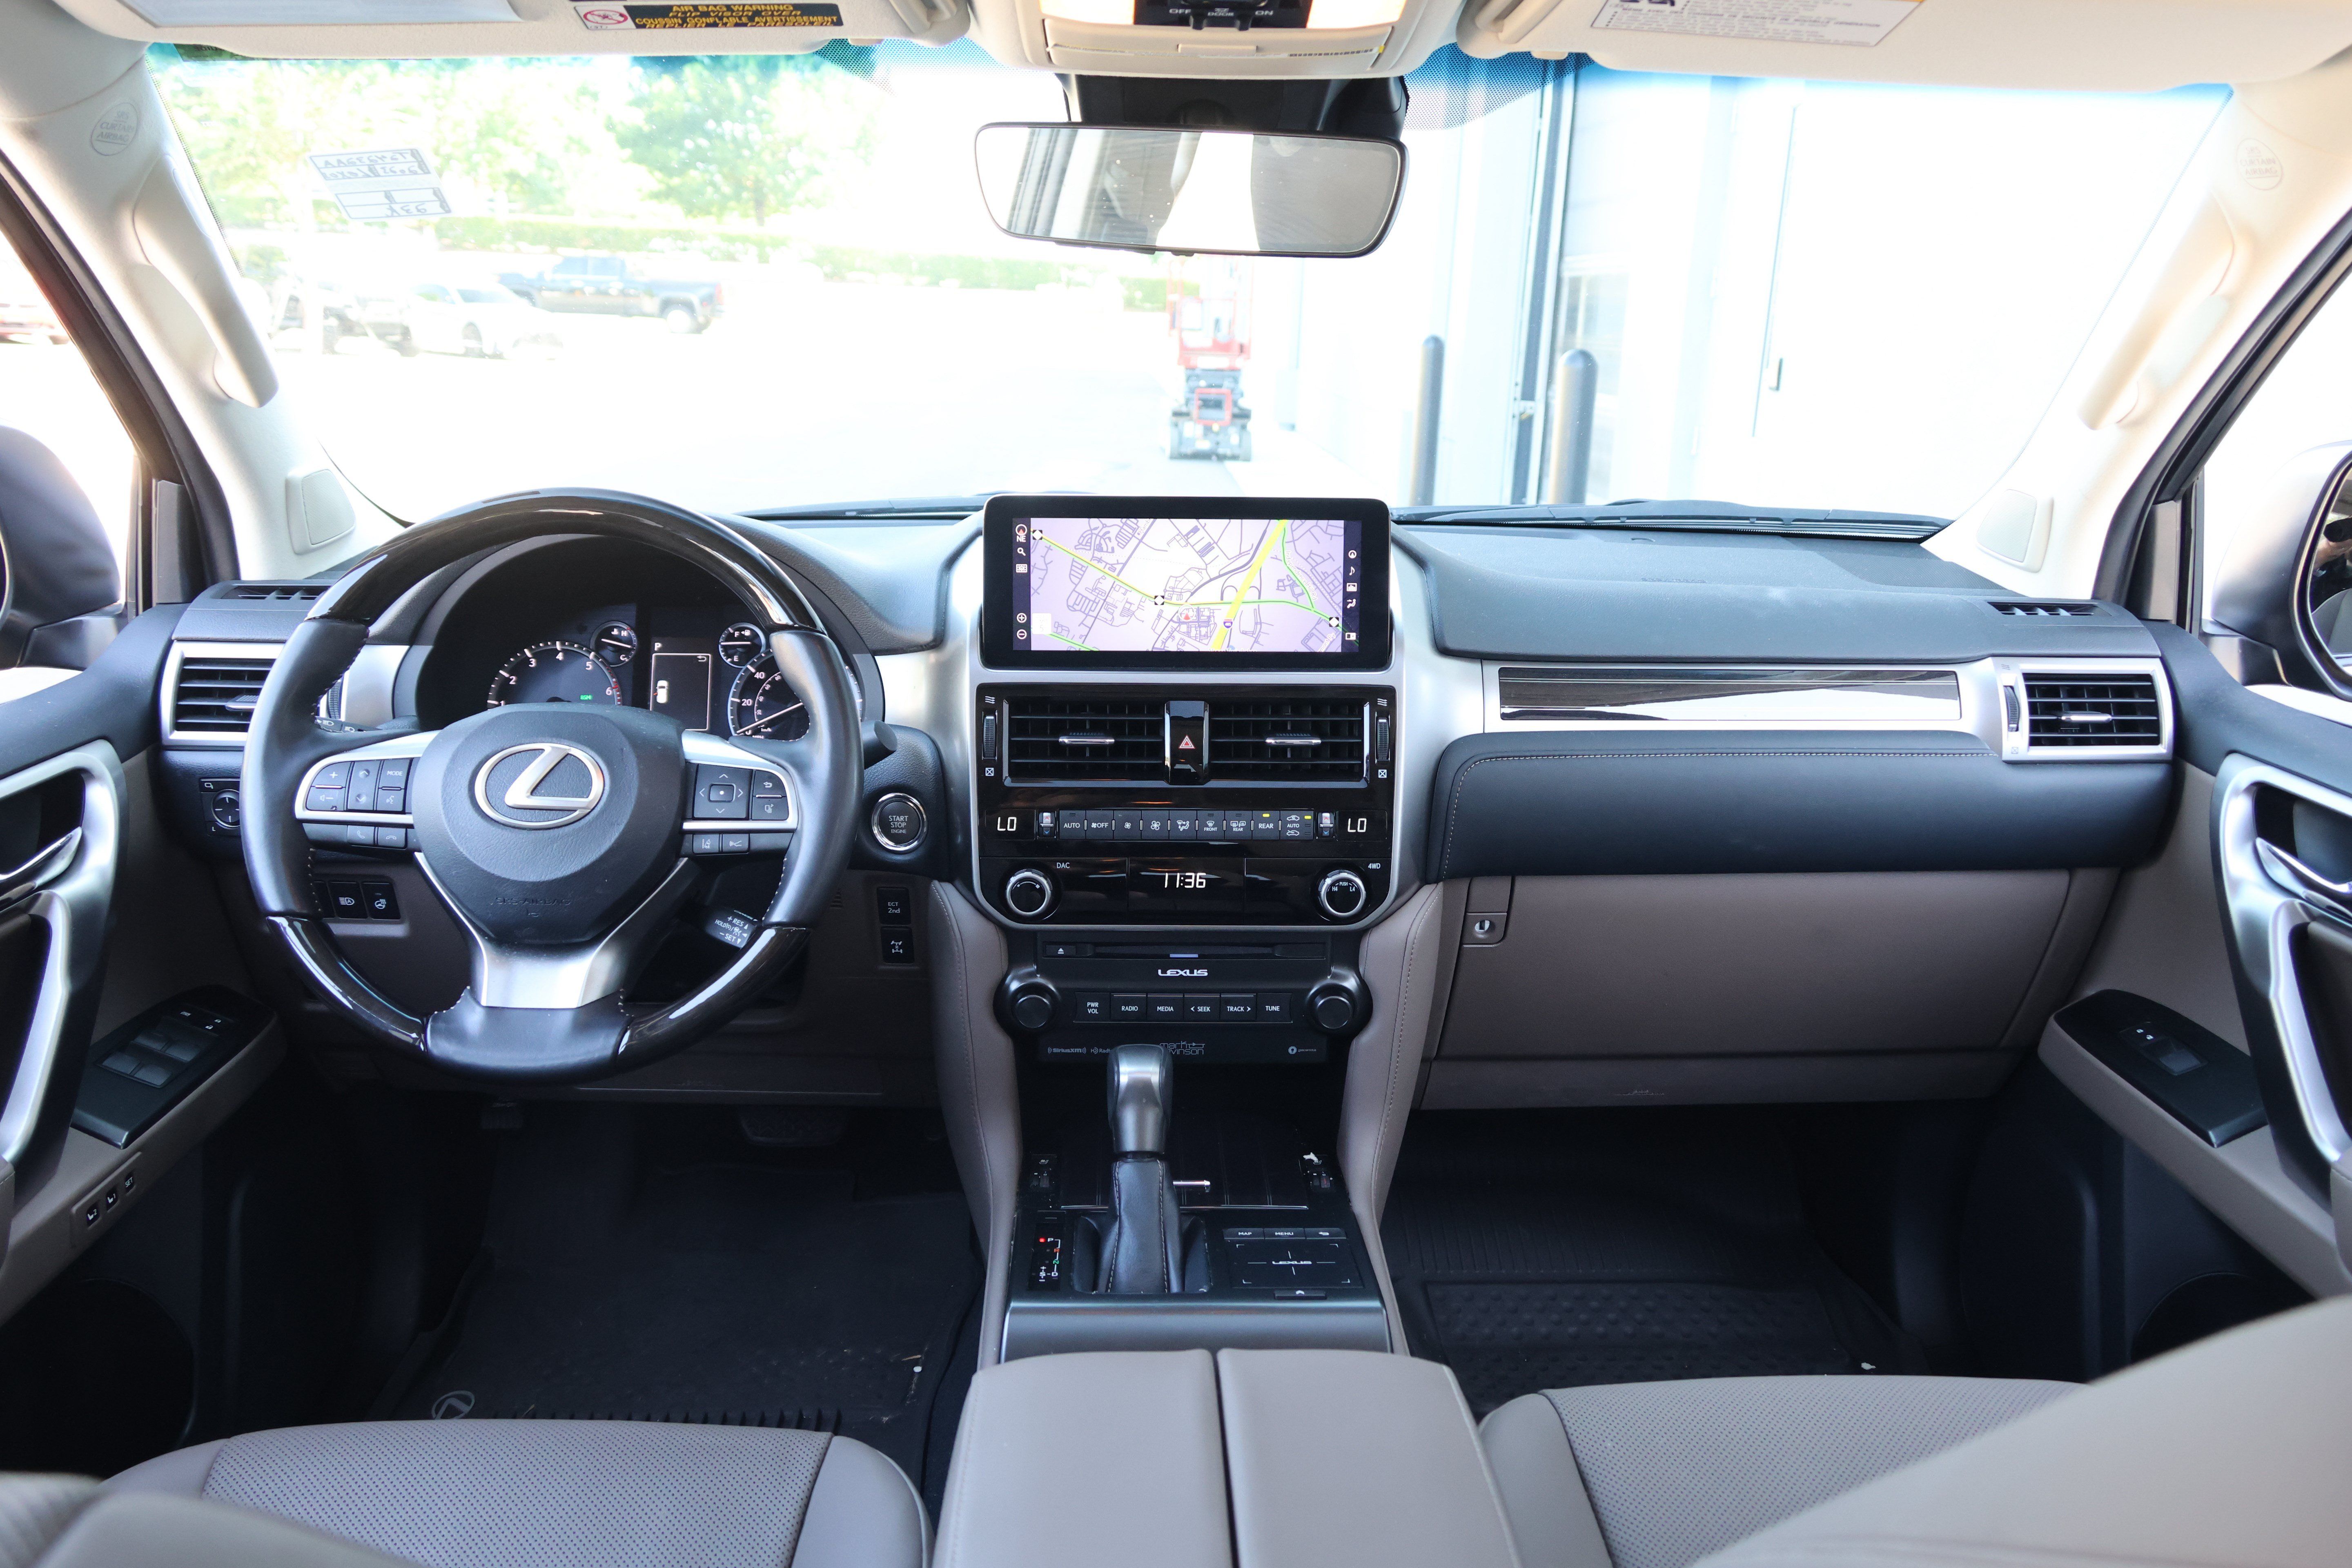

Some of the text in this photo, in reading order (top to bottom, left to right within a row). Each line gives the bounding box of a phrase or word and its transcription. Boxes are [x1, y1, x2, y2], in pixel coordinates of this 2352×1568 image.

[1286, 550, 1318, 601] Independence Hill Rd
[655, 642, 662, 651] P
[556, 652, 564, 661] 4
[529, 658, 537, 668] 3
[586, 662, 593, 670] 5
[509, 676, 517, 684] 2
[606, 687, 613, 695] 6
[997, 817, 1017, 831] LO
[1348, 818, 1367, 833] LO
[1165, 873, 1206, 888] 11:36
[715, 919, 726, 928] HOLD
[732, 918, 744, 927] RES
[724, 933, 736, 942] SET
[1160, 1041, 1187, 1049] mark
[125, 1177, 133, 1188] SET
